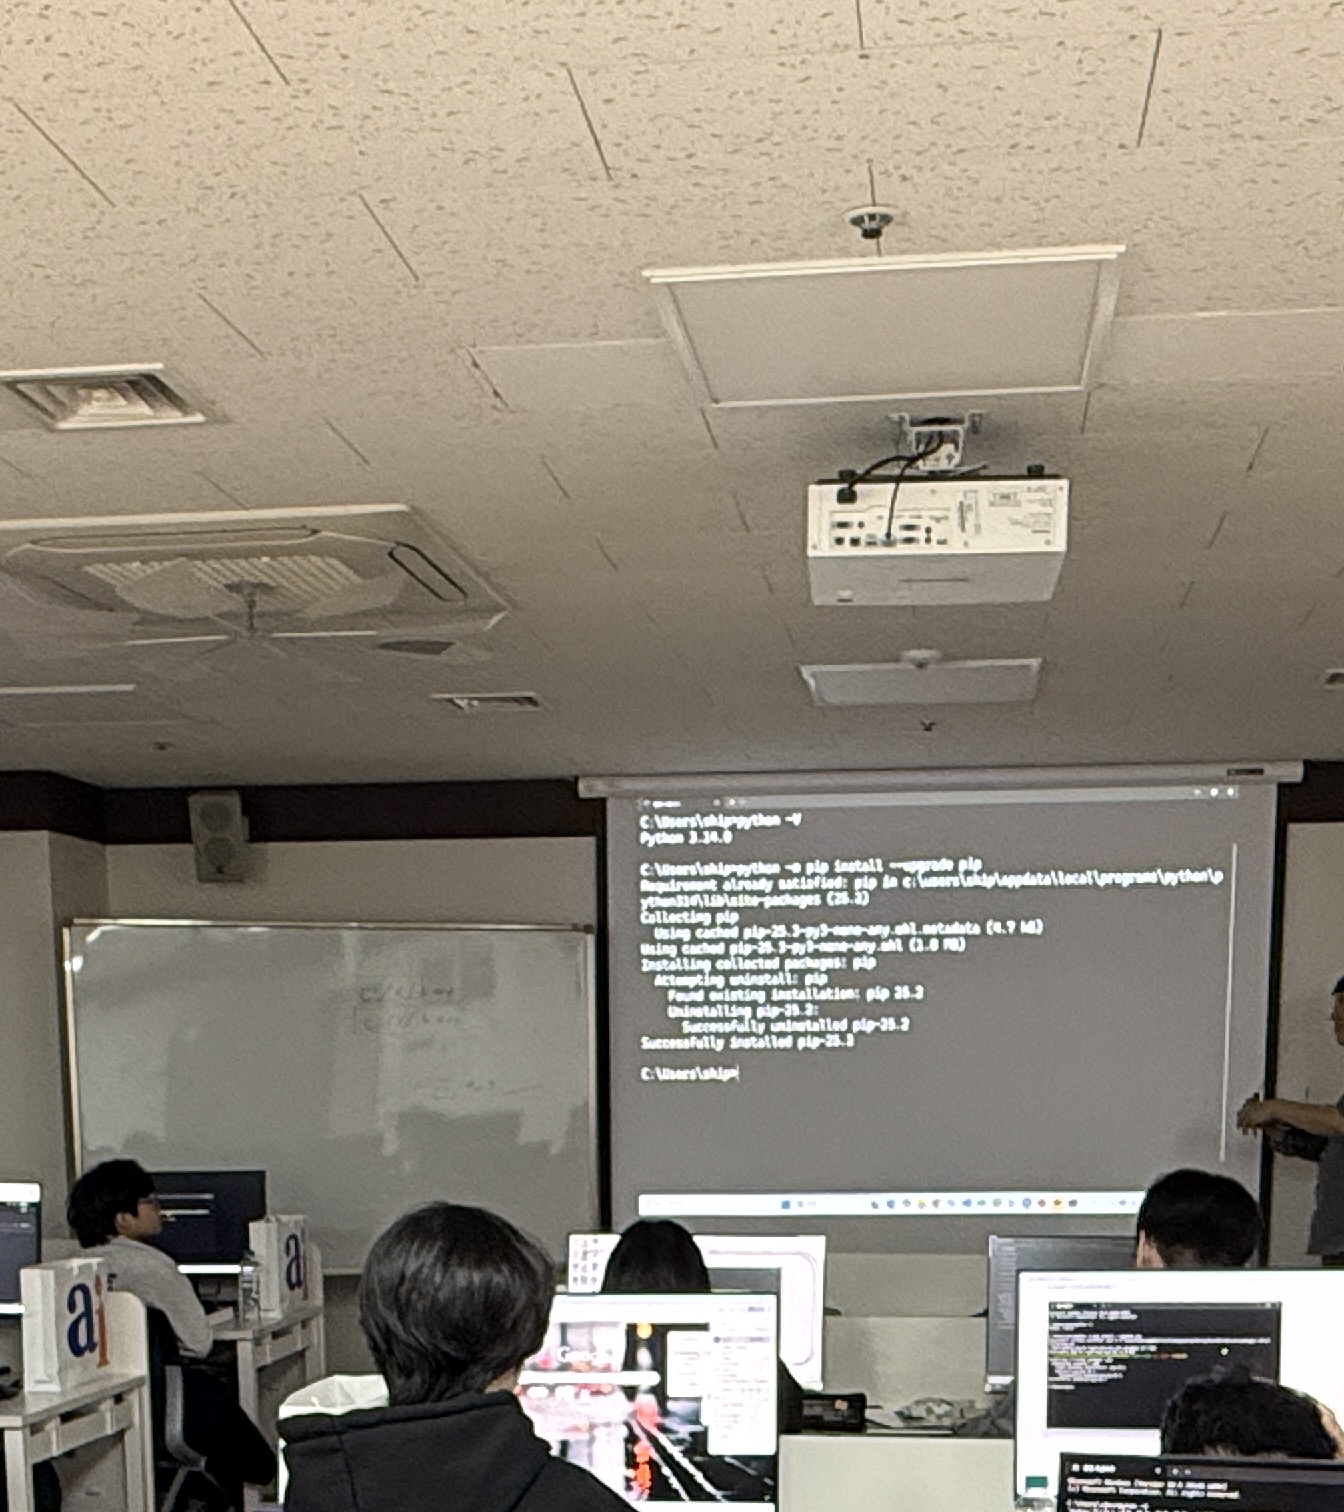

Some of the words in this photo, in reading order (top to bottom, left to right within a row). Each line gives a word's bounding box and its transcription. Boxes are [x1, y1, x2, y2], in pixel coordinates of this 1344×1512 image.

[640, 831, 685, 848] Python
[834, 858, 884, 874] install
[681, 1019, 766, 1035] Successfully
[640, 1036, 725, 1052] Successfully
